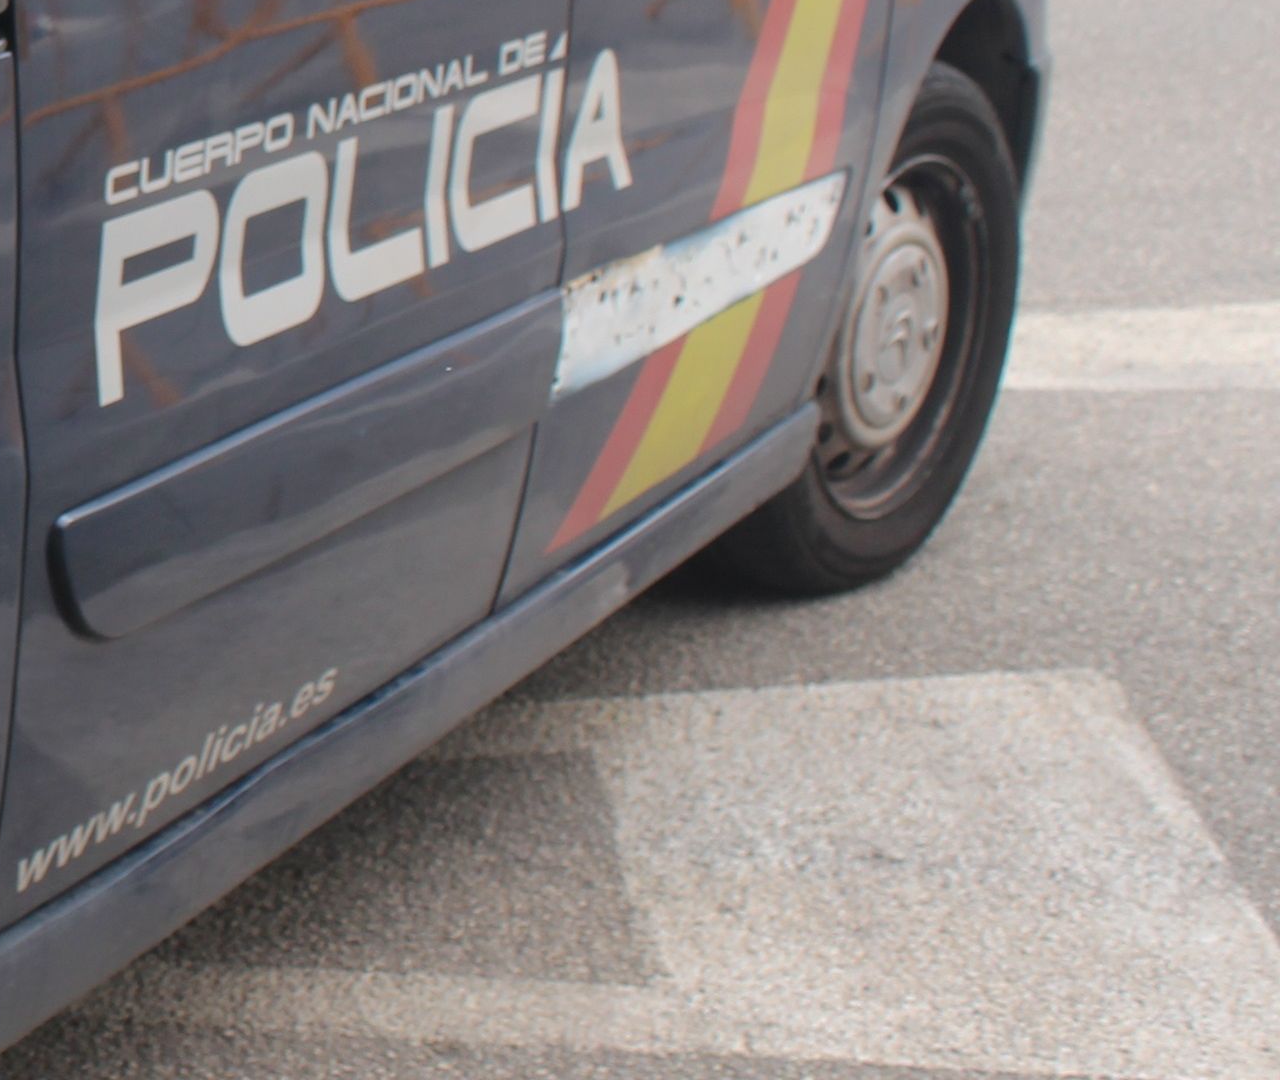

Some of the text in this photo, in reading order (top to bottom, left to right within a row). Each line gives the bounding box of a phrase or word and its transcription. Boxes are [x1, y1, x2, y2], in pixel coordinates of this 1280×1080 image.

[95, 31, 633, 407] POLICÍA
[104, 30, 548, 206] CUERPO NACIONAL DE
[16, 667, 338, 893] www.policia.es
